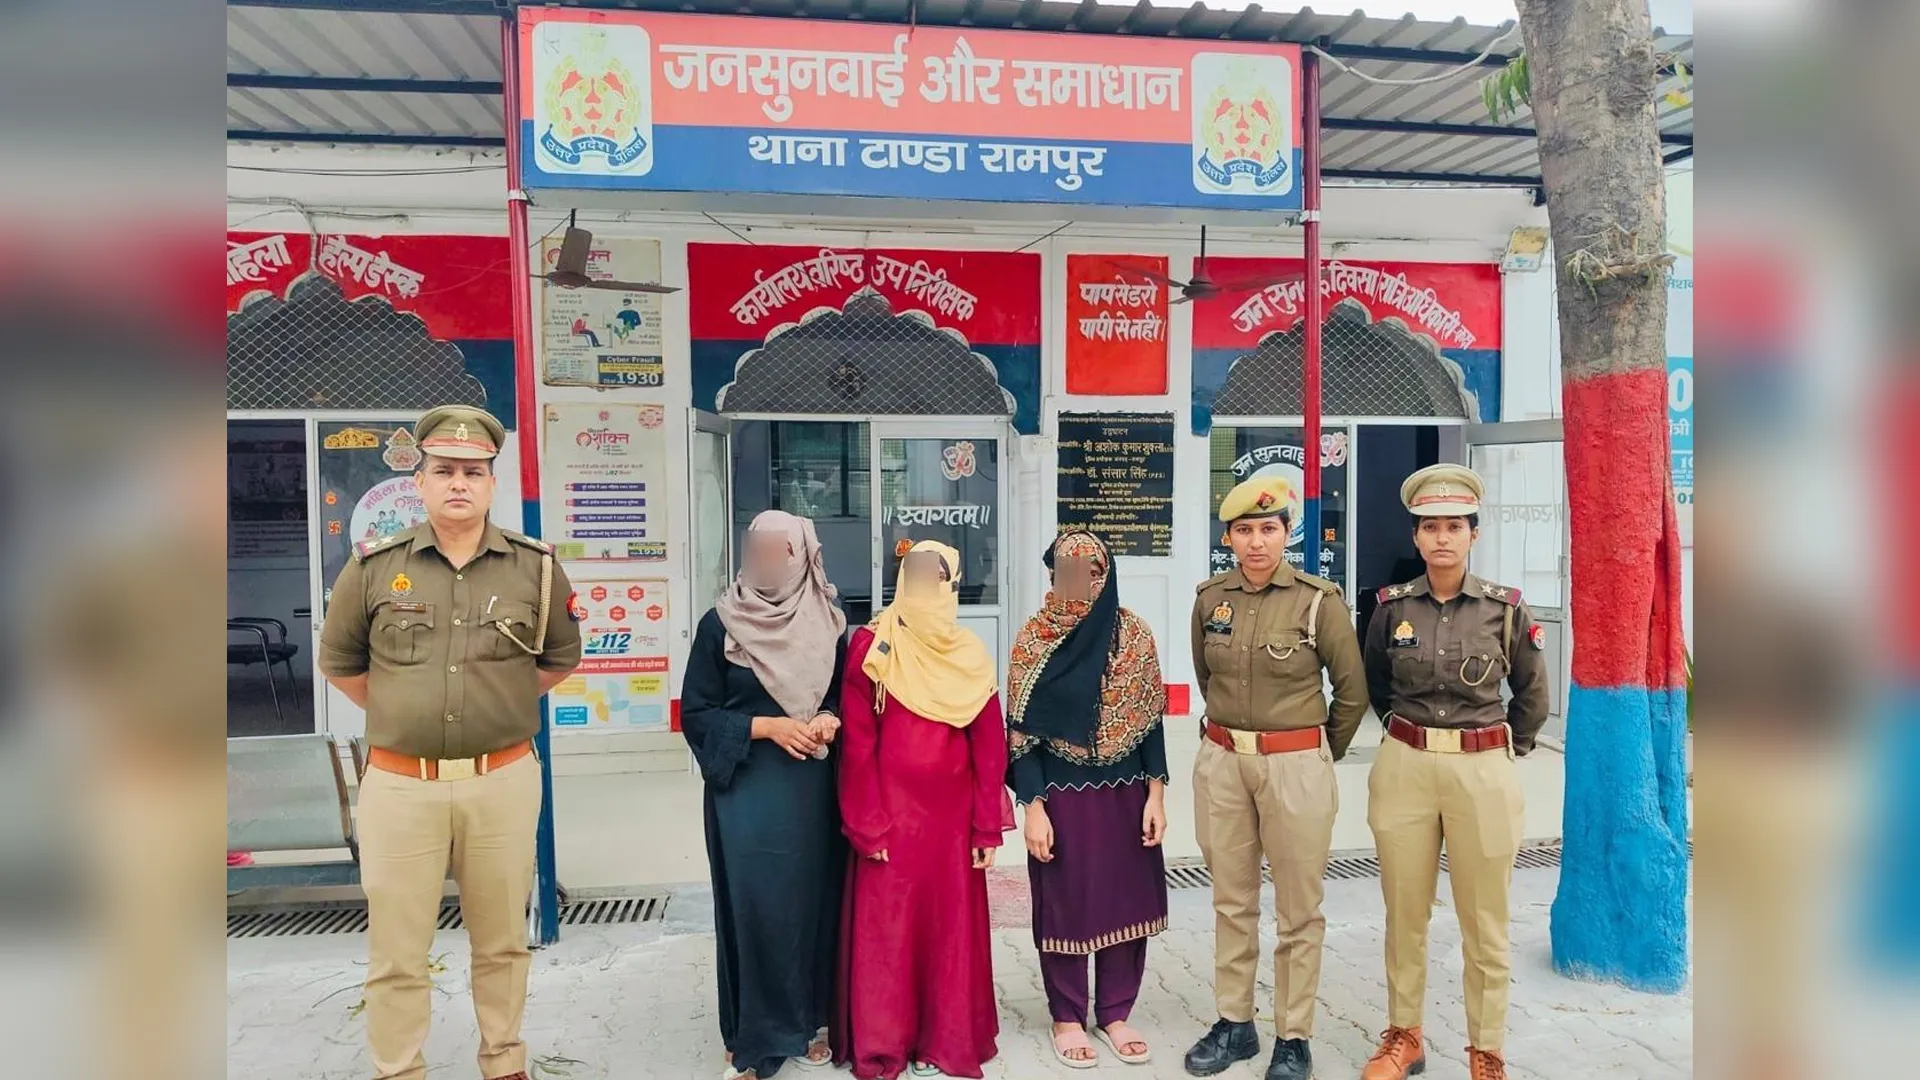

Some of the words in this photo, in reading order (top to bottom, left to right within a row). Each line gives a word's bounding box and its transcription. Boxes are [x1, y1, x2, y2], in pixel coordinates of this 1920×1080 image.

[659, 33, 911, 122] जनसुनवाई
[919, 36, 1004, 104] और
[1012, 60, 1183, 111] समाधान
[748, 134, 849, 166] थाना
[859, 138, 969, 173] टाण्डा
[979, 144, 1107, 191] रामपुर
[804, 248, 865, 289] वरिष्ठ
[870, 254, 909, 291] उप
[904, 259, 978, 321] निरीक्षक
[1231, 292, 1274, 332] जन
[616, 372, 660, 385] 1930
[1101, 466, 1127, 479] संसार
[1230, 452, 1255, 476] जन
[602, 633, 632, 648] 112
